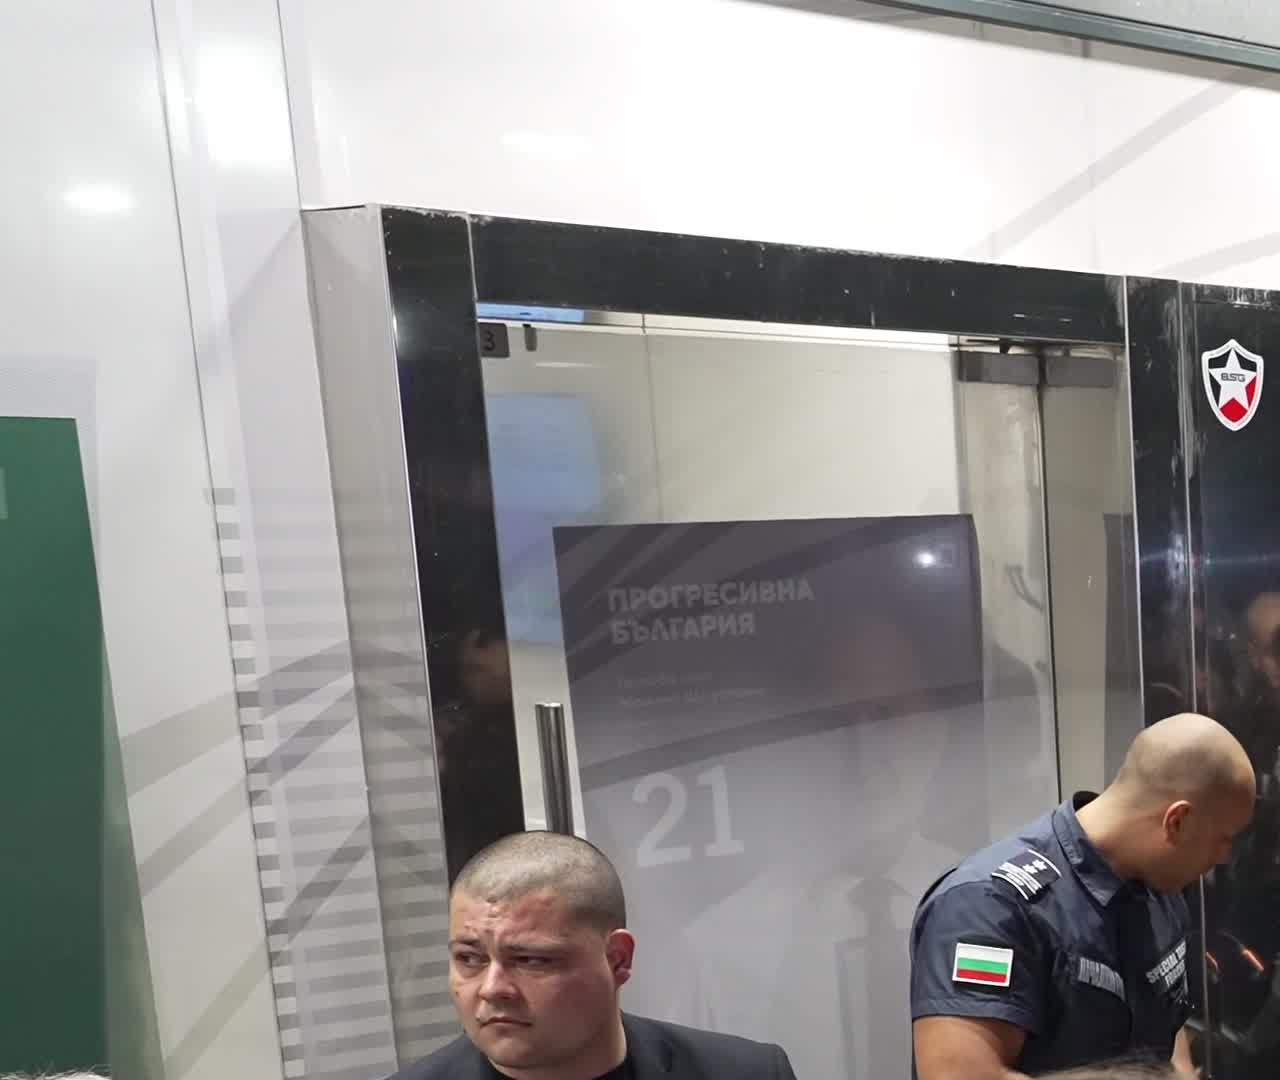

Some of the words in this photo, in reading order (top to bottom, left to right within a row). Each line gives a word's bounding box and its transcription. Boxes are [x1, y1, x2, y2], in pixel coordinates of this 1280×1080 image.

[607, 578, 815, 612] ПРОГРЕСИВНА
[611, 612, 756, 644] БЪЛГАРИЯ
[632, 765, 745, 869] 21
